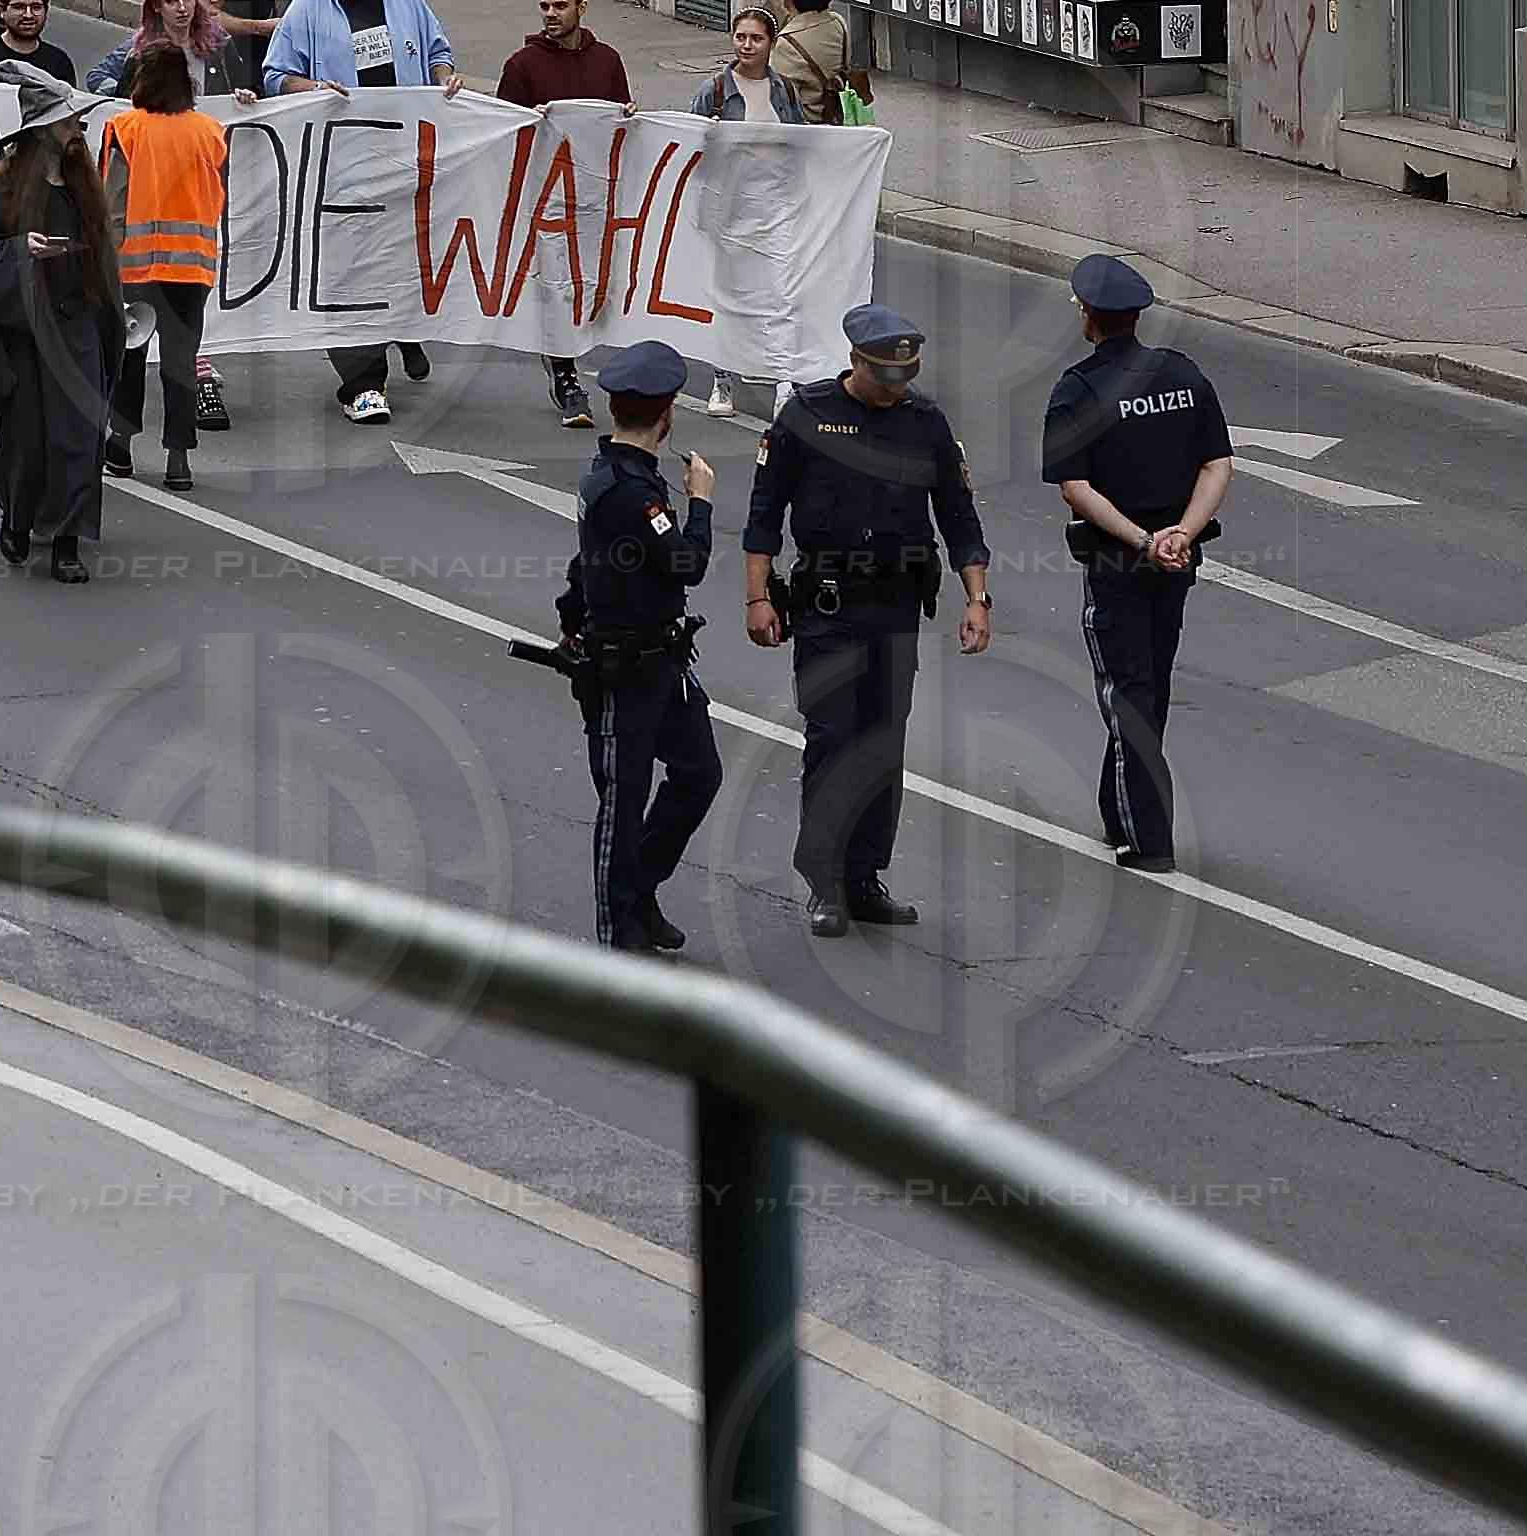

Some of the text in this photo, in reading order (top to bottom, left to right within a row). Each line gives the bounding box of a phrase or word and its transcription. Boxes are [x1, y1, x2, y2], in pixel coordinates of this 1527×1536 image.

[219, 118, 404, 313] DIE
[413, 120, 715, 328] WAHL
[1117, 387, 1197, 421] POLIZEI
[817, 423, 859, 435] POLIZEI
